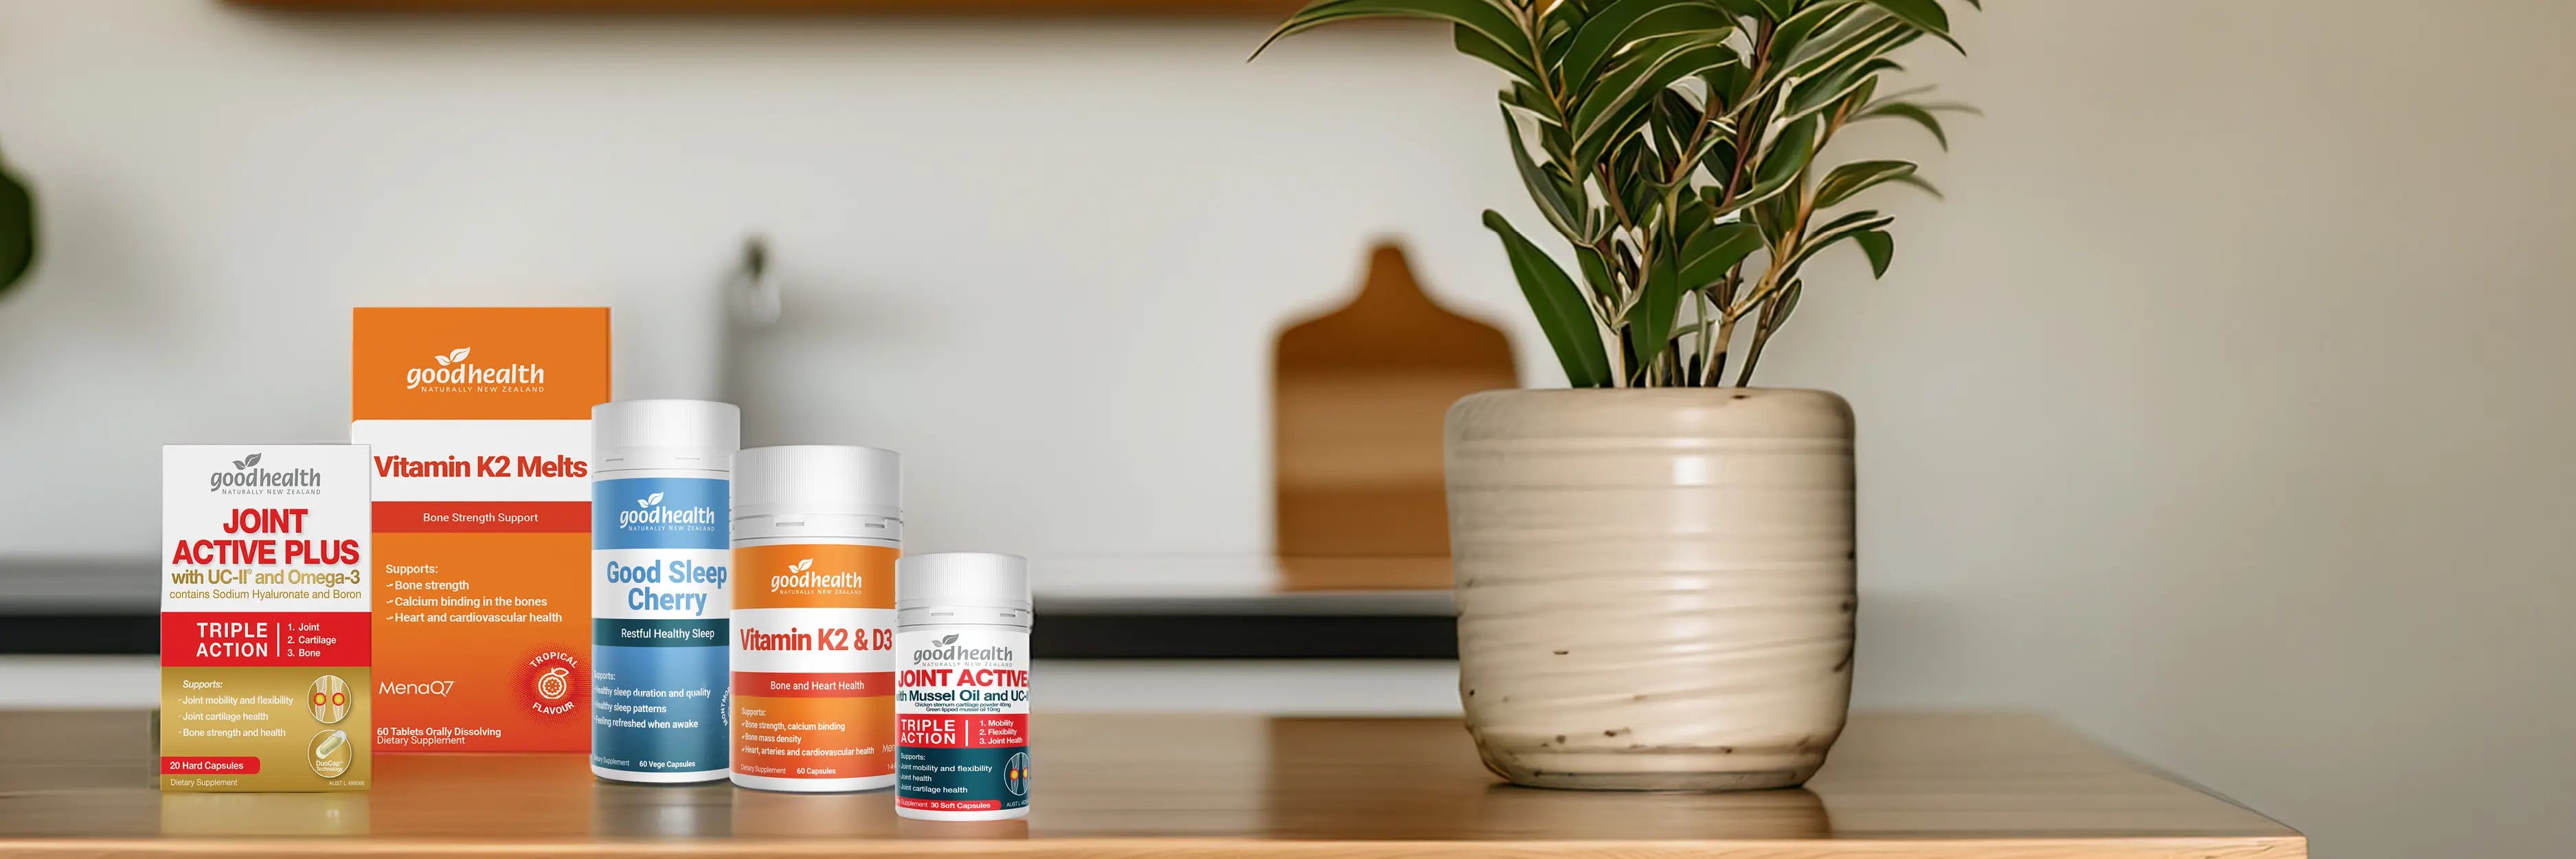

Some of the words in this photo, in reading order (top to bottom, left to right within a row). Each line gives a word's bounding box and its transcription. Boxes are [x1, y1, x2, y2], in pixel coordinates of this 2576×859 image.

[407, 364, 544, 389] goodhealth
[374, 455, 470, 477] Vitamin
[477, 456, 510, 477] K2
[517, 455, 587, 477] Melts
[211, 469, 320, 492] goodhealth
[223, 509, 308, 533] JOINT
[423, 513, 449, 522] Bone
[452, 513, 495, 524] Strength
[498, 513, 538, 524] Support
[620, 506, 714, 529] goodhealth
[172, 539, 275, 564] ACTIVE
[285, 539, 359, 564] PLUS
[386, 564, 438, 575] Supports:
[607, 559, 661, 583] Good
[669, 559, 727, 589] Sleep
[172, 570, 203, 584] with
[256, 570, 284, 584] and
[288, 570, 360, 588] Omega-3
[771, 572, 861, 592] goodhealth
[395, 581, 422, 590] Bone
[425, 581, 469, 592] strength
[170, 590, 210, 599] contains
[213, 590, 249, 599] Sodium
[253, 590, 308, 601] Hyaluronate
[312, 590, 330, 599] and
[334, 590, 361, 599] Boron
[395, 597, 438, 606] Calcium
[441, 597, 480, 608] binding
[483, 597, 493, 606] in
[495, 597, 512, 606] the
[515, 597, 547, 606] bones
[629, 587, 707, 616] Cherry
[395, 613, 425, 622] Heart
[427, 613, 447, 622] and
[450, 613, 527, 622] cardiovascular
[530, 613, 562, 622] health
[196, 623, 267, 638] TRIPLE
[622, 629, 651, 638] Restful
[654, 629, 690, 640] Healthy
[692, 629, 714, 640] Sleep
[298, 636, 336, 645] Cartilage
[741, 627, 811, 650] Vitamin
[818, 628, 848, 650] K2
[854, 628, 868, 650] &
[873, 628, 892, 650] D3
[196, 643, 267, 657] ACTION
[914, 646, 1013, 665] goodhealth
[530, 652, 578, 669] TROPICAL
[899, 669, 952, 687] JOINT
[957, 669, 1028, 687] ACTIVE
[183, 680, 223, 689] Supports:
[379, 681, 454, 697] MenaQ7
[771, 681, 790, 689] Bone
[793, 681, 809, 690] and
[812, 681, 836, 690] Heart
[839, 681, 864, 689] Health
[613, 688, 631, 698] sleep
[633, 689, 666, 698] duration
[669, 689, 683, 698] and
[686, 689, 711, 698] quality
[909, 690, 955, 701] Mussel
[960, 690, 980, 701] Oil
[984, 690, 1008, 701] and
[205, 697, 238, 706] mobility
[257, 696, 293, 706] flexibility
[532, 702, 575, 714] FLAVOUR
[613, 703, 631, 713] sleep
[633, 704, 666, 714] patterns
[742, 708, 766, 717] Supports:
[205, 713, 240, 722] cartilage
[613, 718, 646, 728] refreshed
[759, 722, 787, 731] strength,
[818, 722, 845, 732] binding
[901, 719, 955, 731] TRIPLE
[207, 728, 240, 738] strength
[391, 728, 423, 736] Tablets
[426, 728, 451, 737] Orally
[454, 728, 501, 737] Dissolving
[377, 737, 409, 746] Dietary
[411, 737, 465, 746] Supplement
[777, 735, 801, 744] density
[901, 733, 955, 744] ACTION
[745, 746, 760, 755] Heart,
[856, 747, 874, 755] health
[205, 761, 243, 771] Capsules
[667, 761, 695, 769] Capsules
[170, 779, 194, 788] Dietary
[196, 779, 237, 788] Supplement
